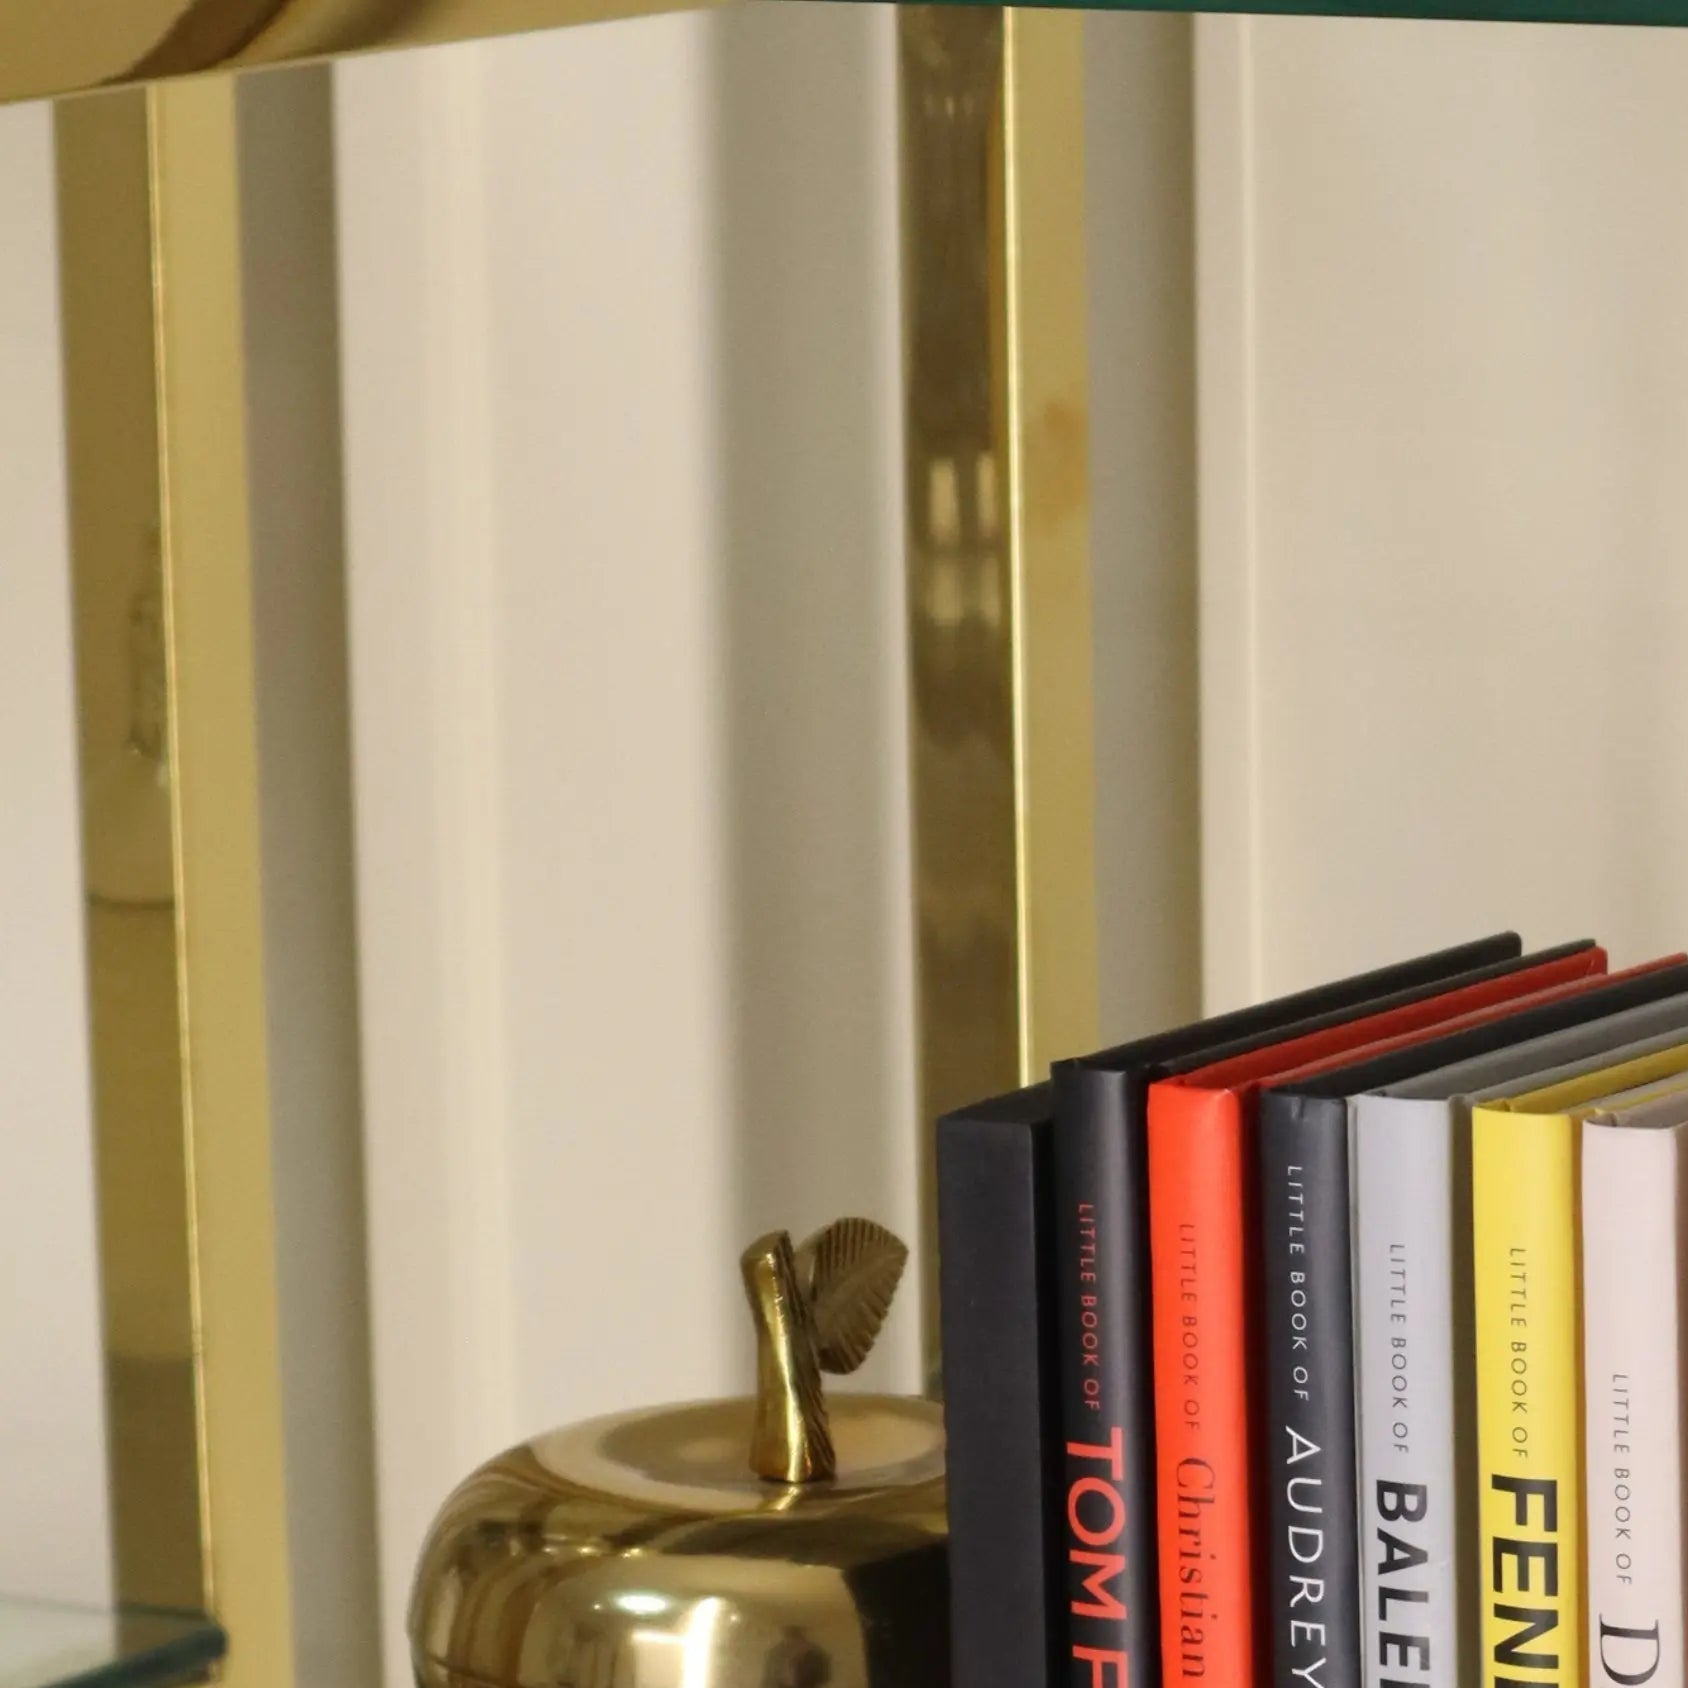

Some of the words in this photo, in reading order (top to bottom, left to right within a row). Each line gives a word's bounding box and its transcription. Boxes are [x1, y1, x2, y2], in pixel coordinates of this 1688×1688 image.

[1078, 1203, 1095, 1284] LITTLE
[1287, 1165, 1304, 1255] LITTLE
[1179, 1224, 1197, 1302] LITTLE
[1390, 1244, 1406, 1323] LITTLE
[1510, 1248, 1527, 1328] LITTLE
[1081, 1296, 1099, 1366] BOOK
[1290, 1271, 1307, 1351] BOOK
[1182, 1316, 1198, 1386] BOOK
[1293, 1366, 1309, 1401] OF
[1391, 1338, 1407, 1408] BOOK
[1511, 1342, 1527, 1414] BOOK
[1083, 1379, 1100, 1411] OF
[1184, 1401, 1200, 1432] OF
[1612, 1374, 1630, 1454] LITTLE
[1393, 1422, 1409, 1453] OF
[1512, 1427, 1528, 1459] OF
[1066, 1427, 1127, 1620] TOM
[1614, 1468, 1631, 1540] BOOK
[1176, 1457, 1219, 1679] Christian
[1616, 1554, 1632, 1585] OF
